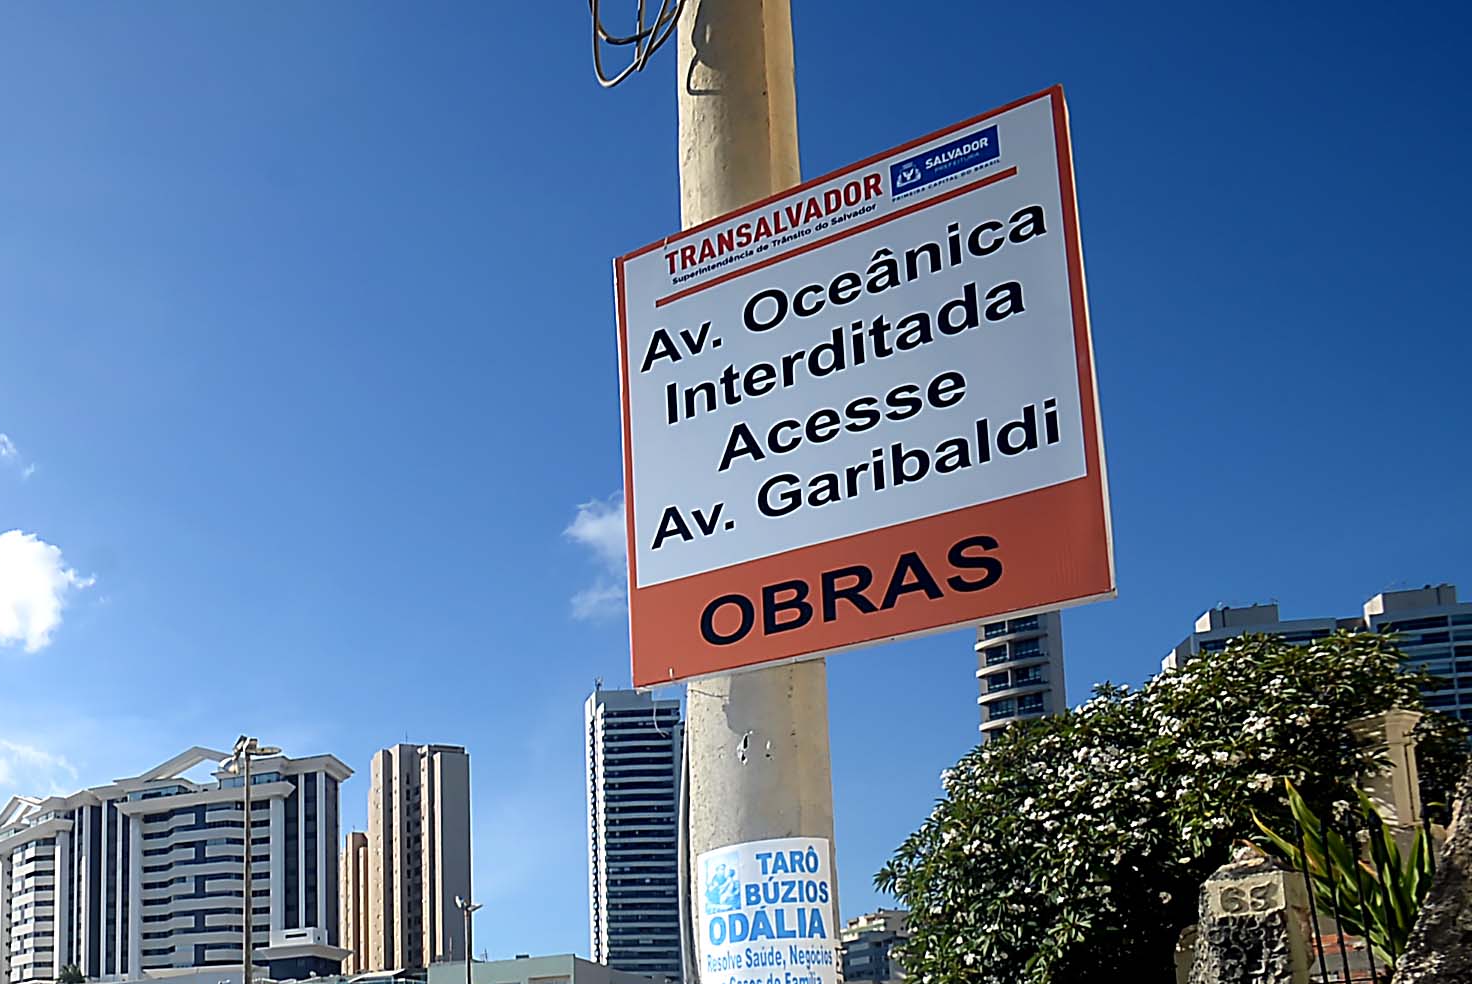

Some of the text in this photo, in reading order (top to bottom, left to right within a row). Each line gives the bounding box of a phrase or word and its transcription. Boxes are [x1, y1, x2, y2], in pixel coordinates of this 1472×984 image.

[925, 137, 988, 169] SALVADOR
[928, 175, 958, 189] CAPITAL
[961, 169, 972, 177] DO
[974, 159, 1000, 172] BRASIL
[664, 173, 883, 275] TRANSALVADOR
[672, 203, 877, 285] Superintendência de Trânsito do Salvador
[640, 203, 1047, 374] Av. Oceânica
[666, 279, 1026, 424] Interditada
[718, 370, 967, 473] Acesse
[651, 397, 1061, 550] Av. Garibaldi
[699, 535, 1004, 647] OBRAS
[745, 877, 829, 906] BÚZIOS
[756, 845, 819, 875] TARÔ
[707, 944, 833, 972] Resolve Saúde, Negócios
[709, 906, 827, 946] ODÁLIA
